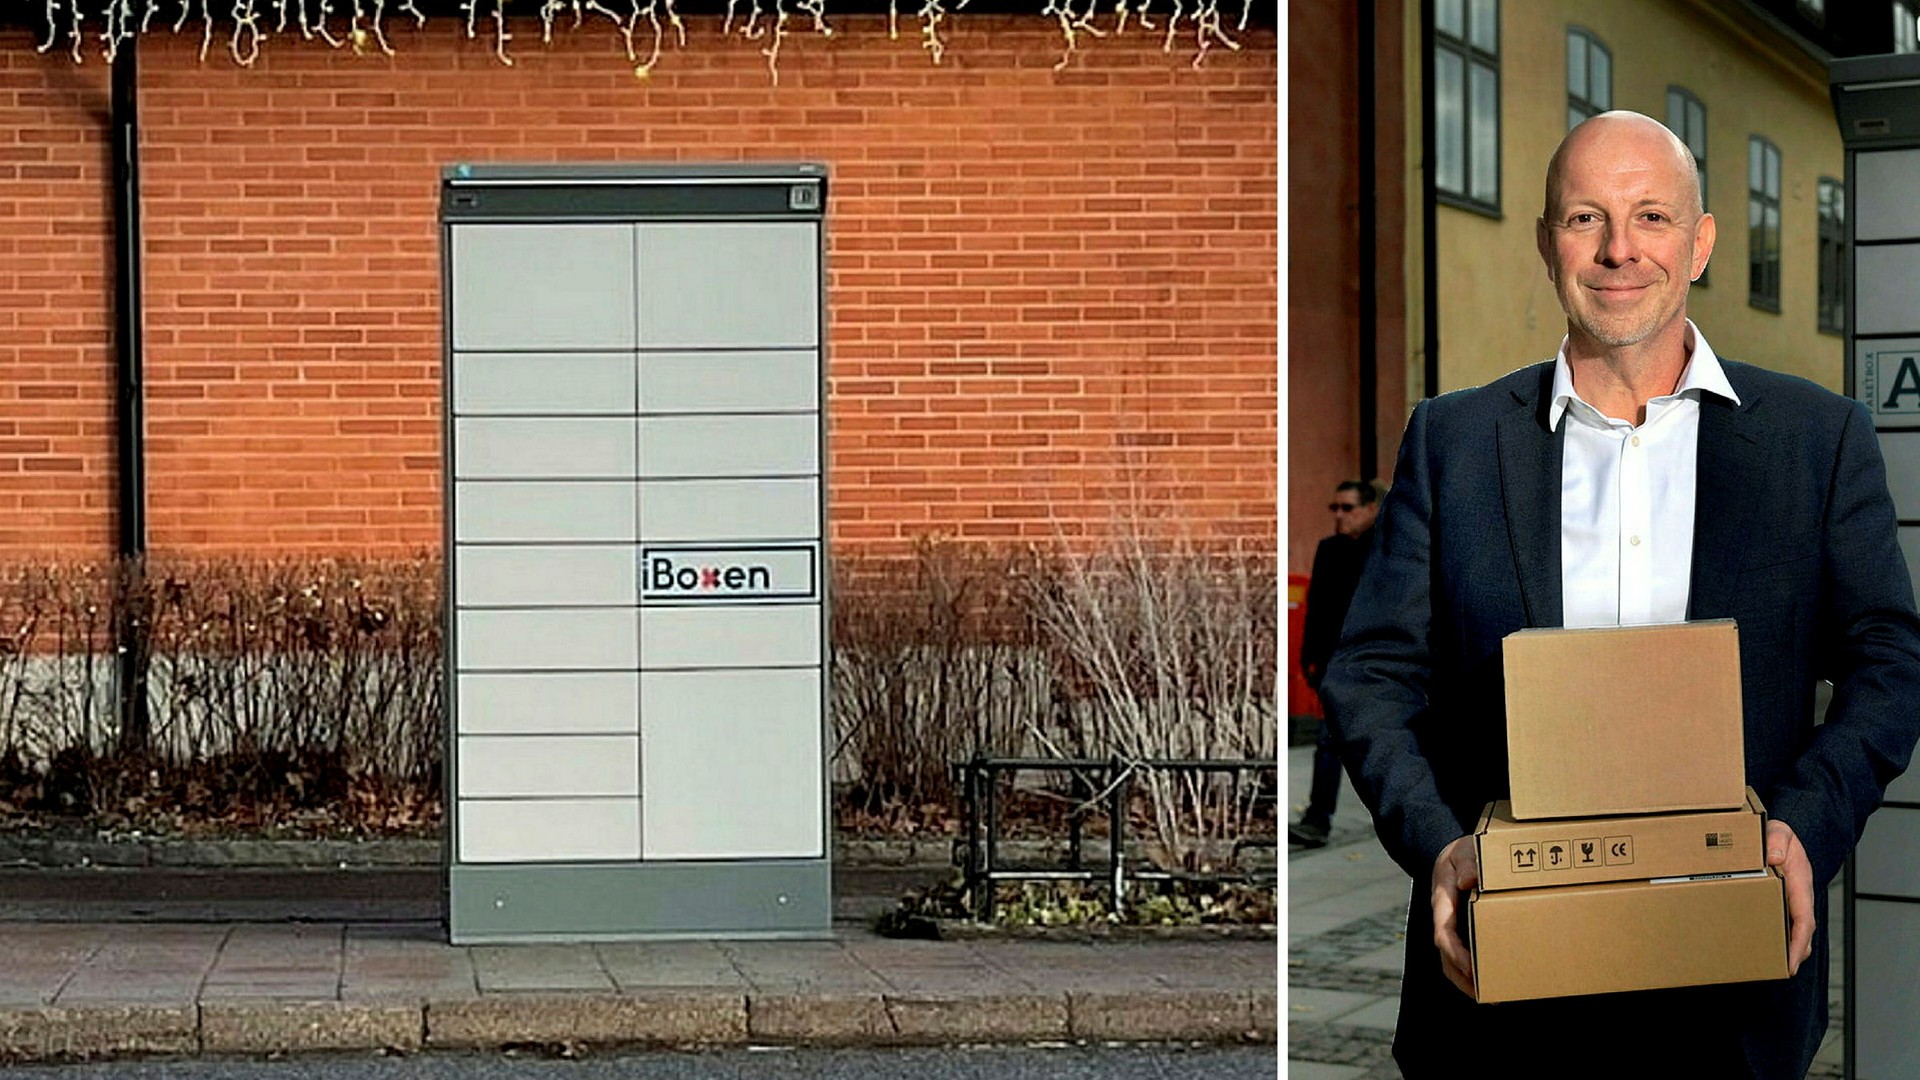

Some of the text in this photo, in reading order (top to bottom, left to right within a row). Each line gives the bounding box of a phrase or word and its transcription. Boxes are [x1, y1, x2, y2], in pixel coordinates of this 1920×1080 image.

[1882, 357, 1920, 408] A
[642, 558, 770, 590] iBoxen
[1611, 842, 1627, 857] CE
